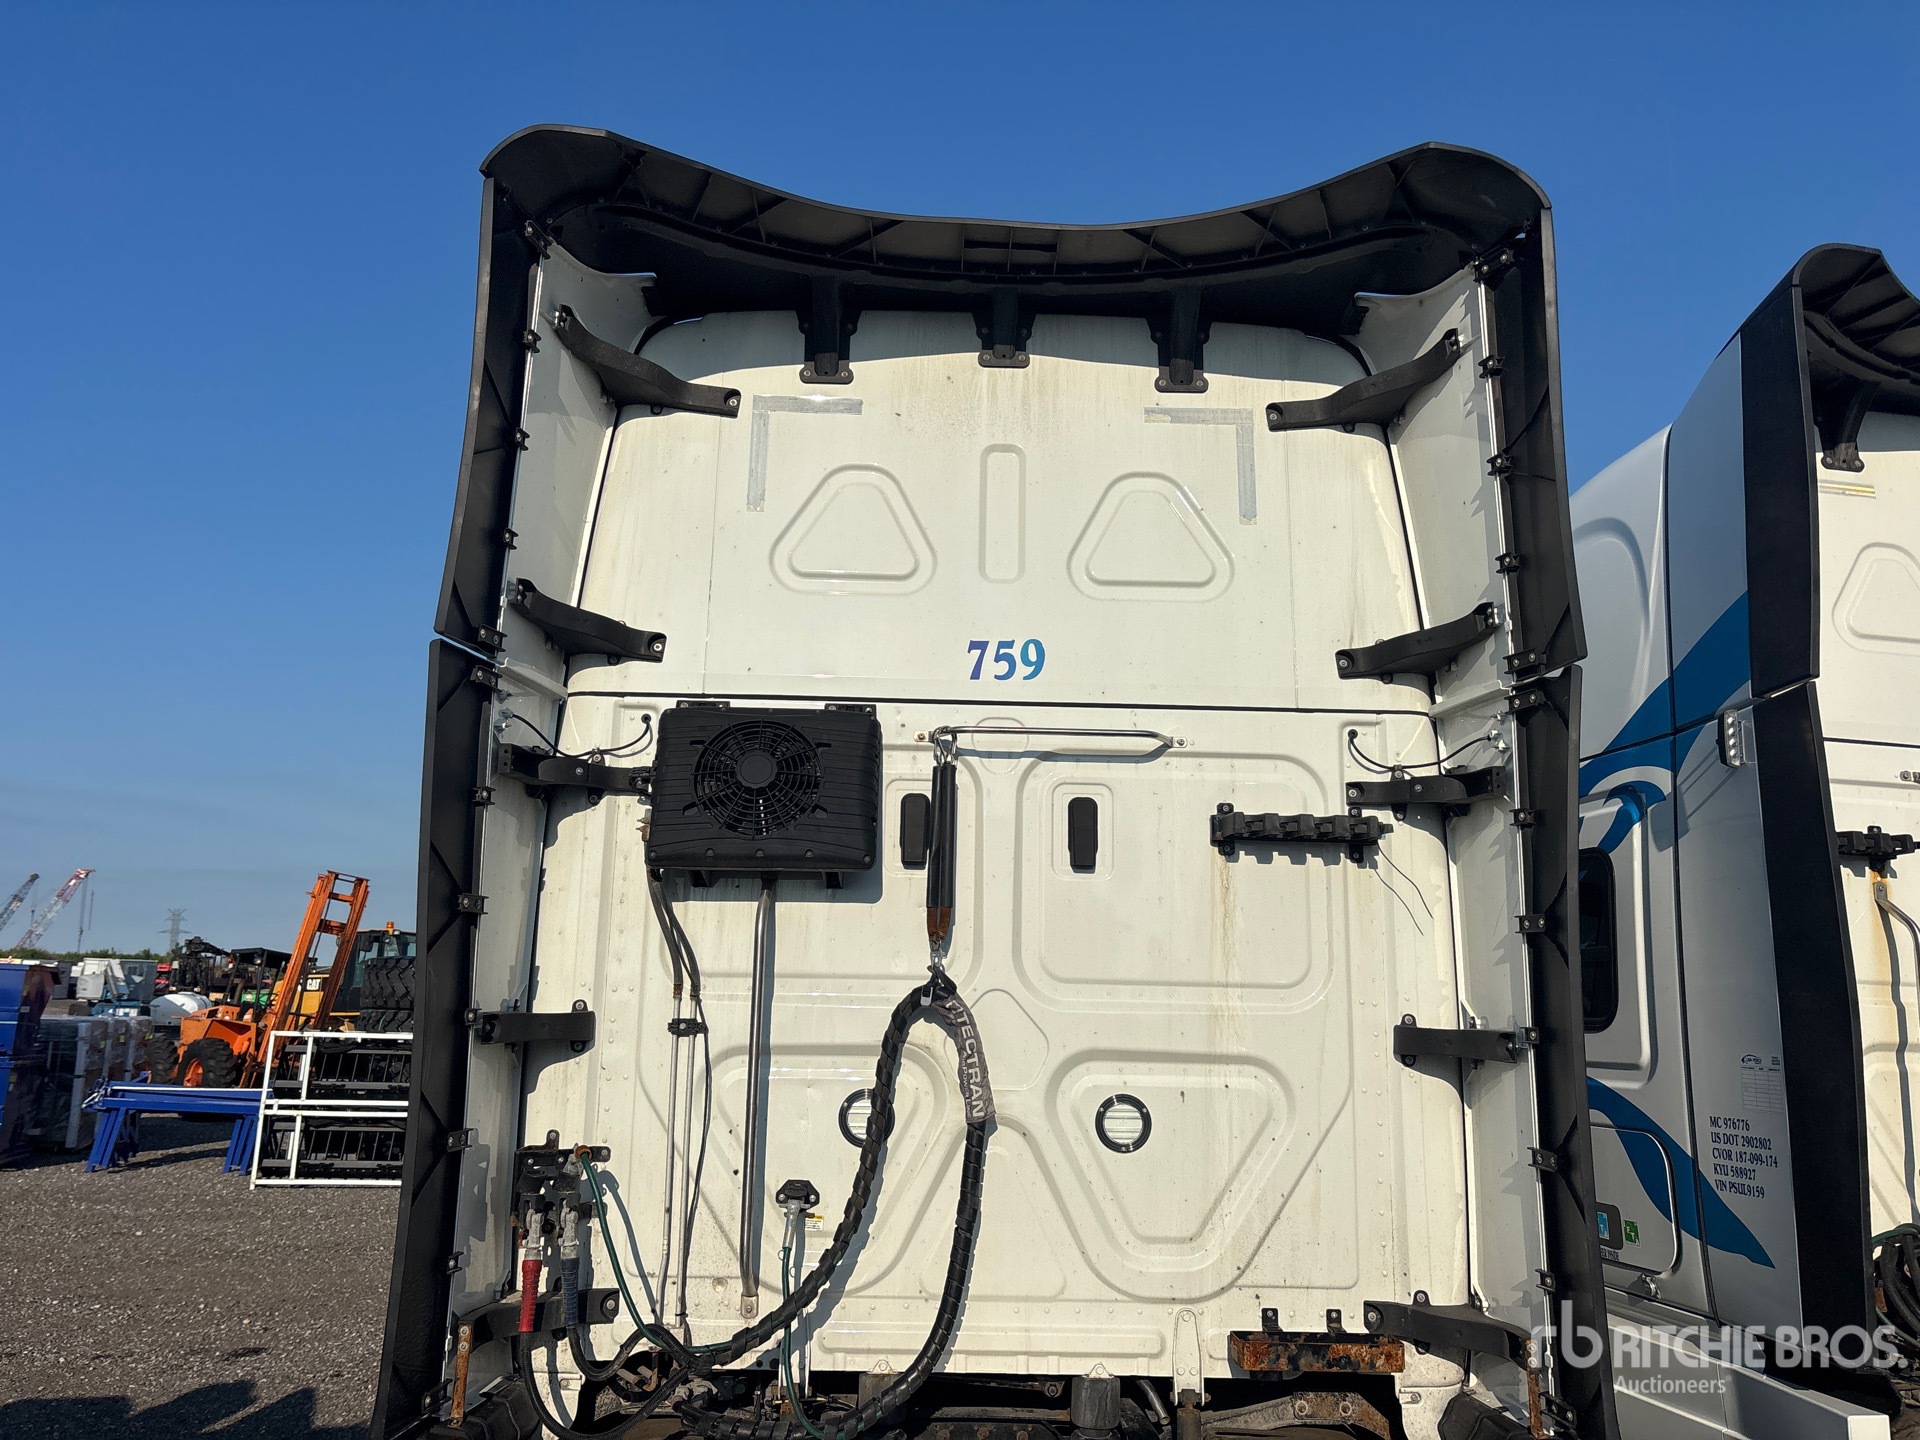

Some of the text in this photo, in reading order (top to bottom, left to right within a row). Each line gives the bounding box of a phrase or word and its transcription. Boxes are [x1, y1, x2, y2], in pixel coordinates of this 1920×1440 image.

[967, 639, 1046, 681] 759
[306, 979, 320, 990] CAT
[957, 1011, 986, 1118] TECTRAN
[1709, 1116, 1750, 1131] MC 976776
[1711, 1132, 1772, 1150] US DOT 2902802
[1712, 1147, 1778, 1168] CVOR 187-099-174
[1713, 1163, 1756, 1180] KYU 588927
[1715, 1179, 1728, 1192] VIN
